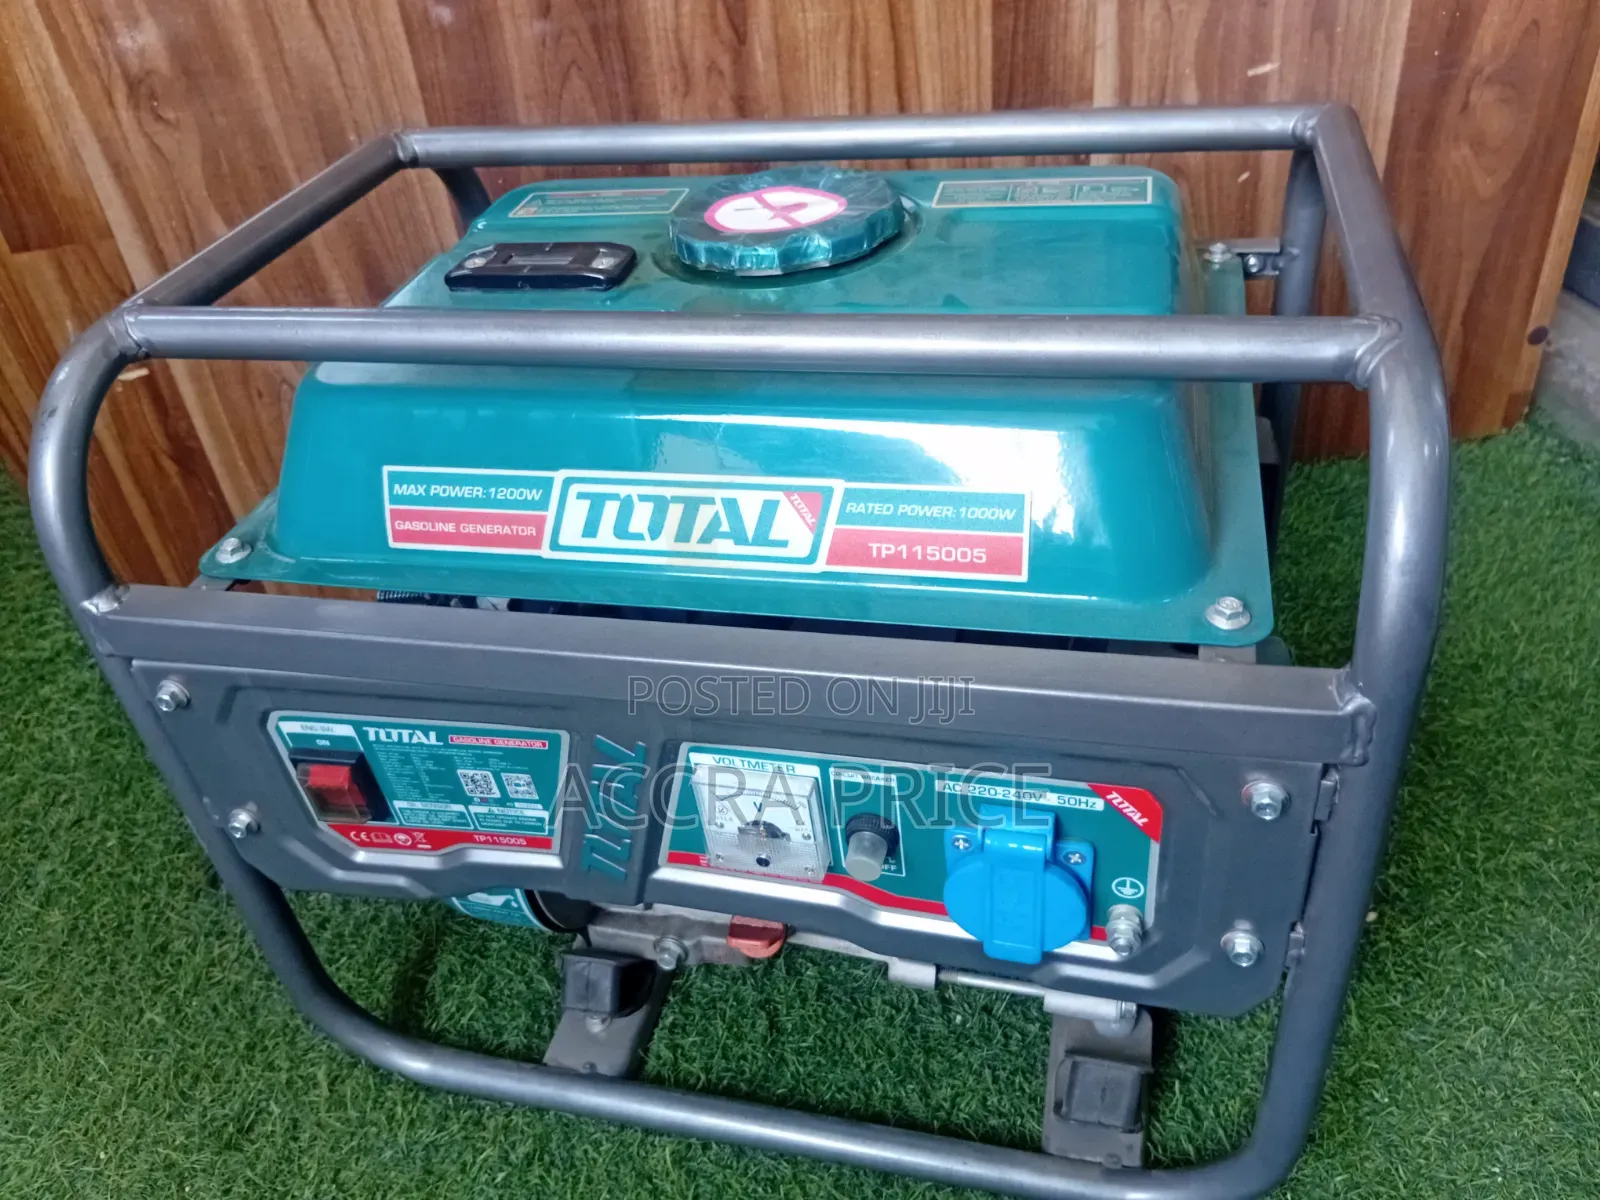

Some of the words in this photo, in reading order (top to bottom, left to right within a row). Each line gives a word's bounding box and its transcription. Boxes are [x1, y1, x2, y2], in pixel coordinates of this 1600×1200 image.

[393, 484, 427, 496] MAX
[790, 492, 817, 527] TOTAL
[845, 502, 894, 515] RATED
[394, 520, 457, 533] GASOLINE
[460, 523, 536, 536] GENERATOR
[575, 491, 789, 549] TOTAL
[868, 543, 987, 564] TP115005
[363, 727, 444, 746] TOTAL
[452, 735, 492, 745] GASOLINE
[494, 737, 544, 748] GENERATOR
[711, 755, 796, 774] VOLTMETER
[943, 782, 963, 793] AC
[1057, 795, 1097, 809] 50Hz
[1106, 790, 1149, 827] TOTAL
[473, 834, 527, 846] TP115005
